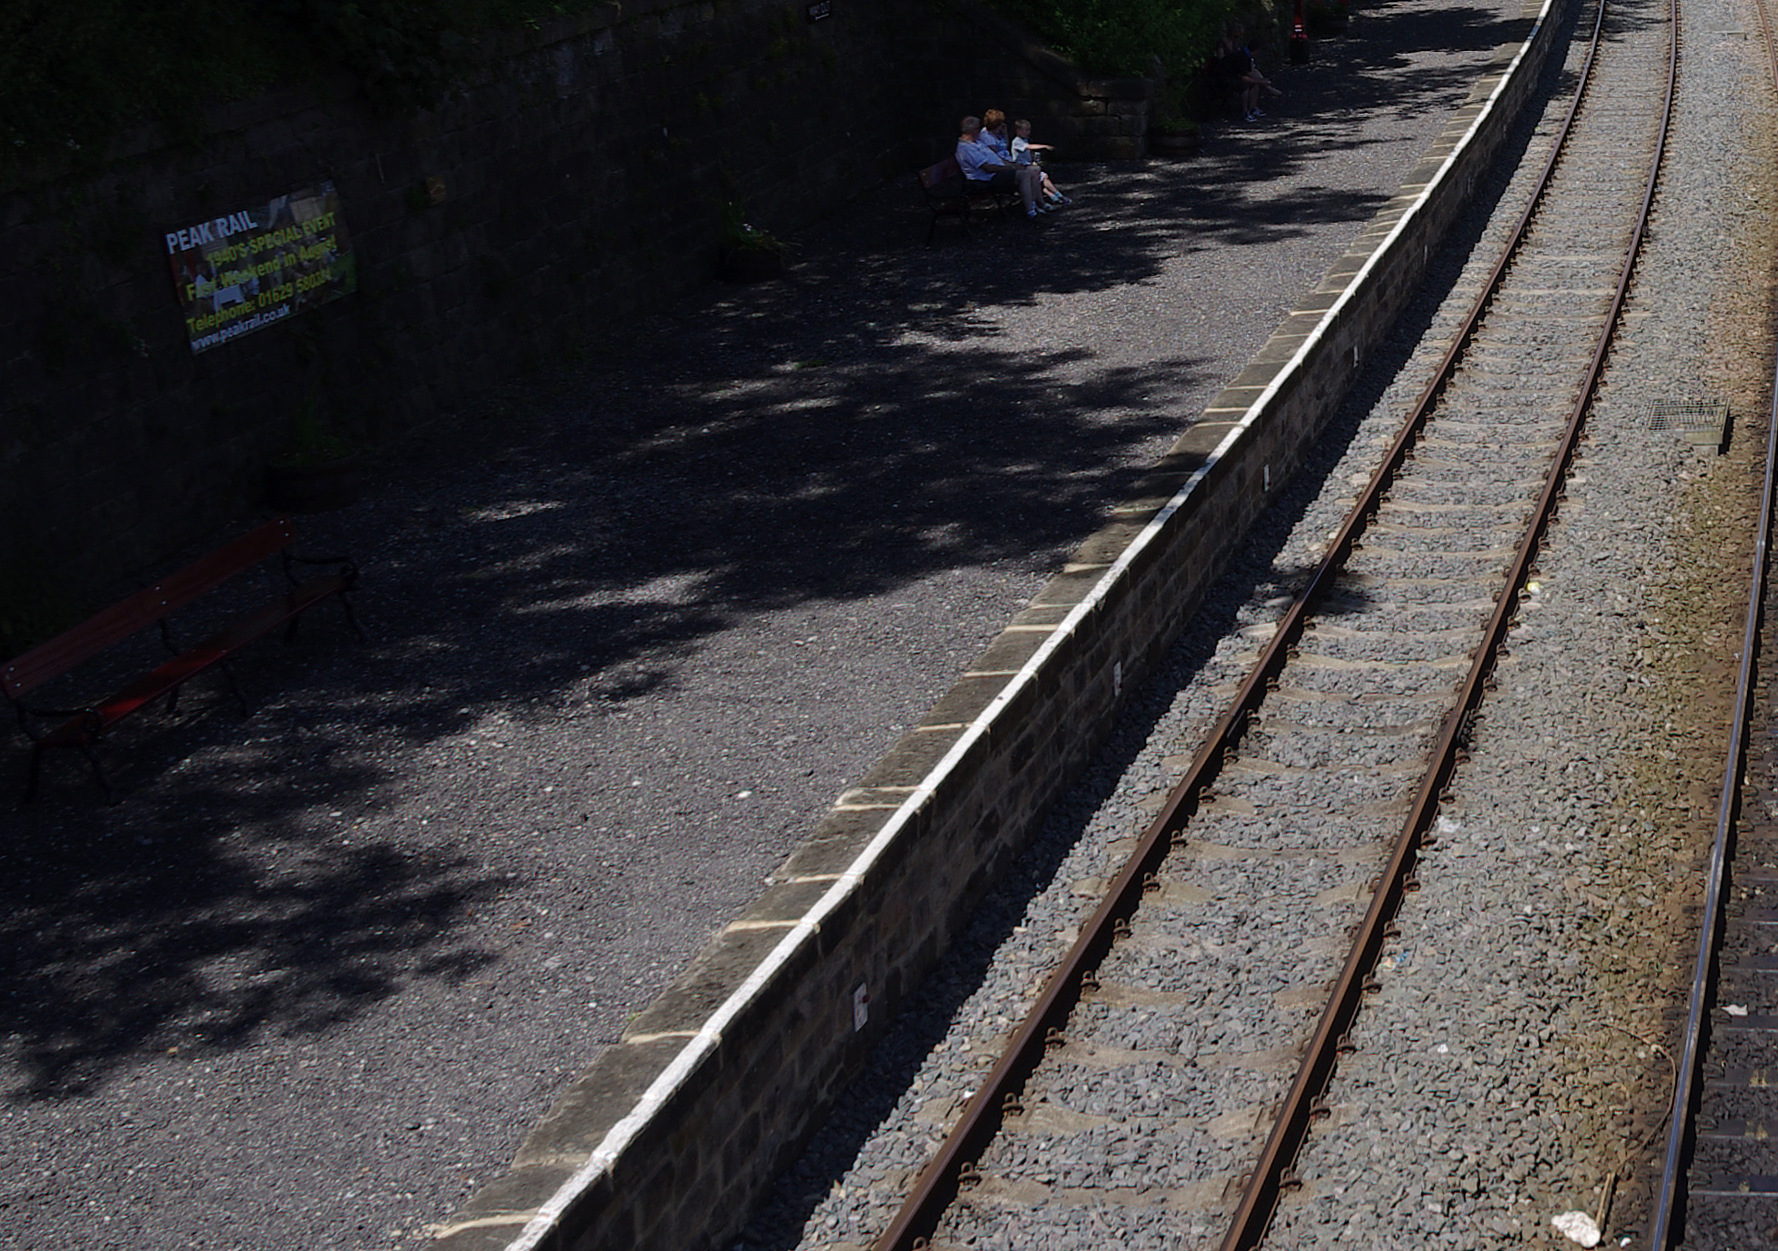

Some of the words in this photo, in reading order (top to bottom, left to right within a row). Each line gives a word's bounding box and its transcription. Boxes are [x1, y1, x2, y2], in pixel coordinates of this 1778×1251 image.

[166, 221, 214, 255] PEAK
[215, 210, 259, 239] RAIL
[206, 242, 248, 267] 1940'S
[248, 225, 303, 255] SPECIAL
[303, 211, 337, 238] EVENT
[220, 257, 282, 288] Weekend
[283, 250, 296, 267] in
[186, 298, 256, 335] Telephone:
[258, 281, 294, 309] 01629
[189, 302, 292, 352] www.peakrail.co.uk
